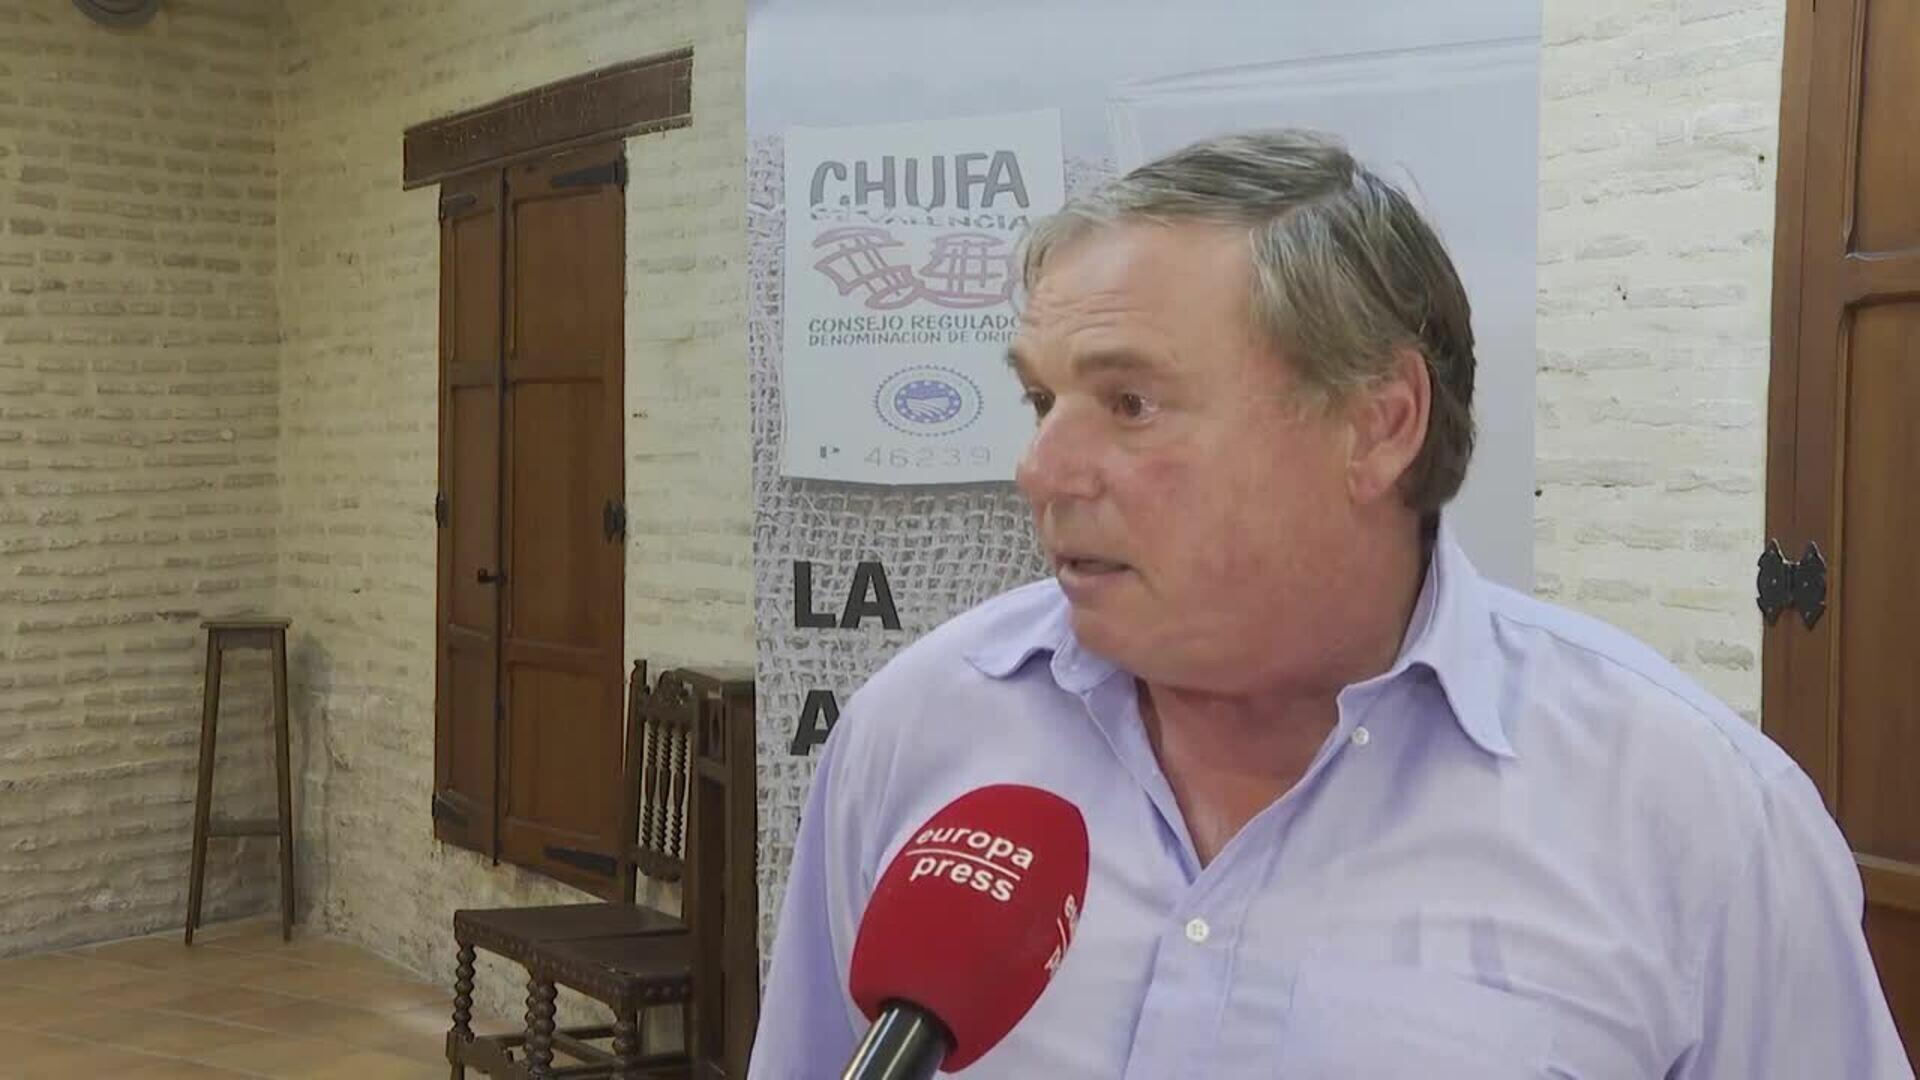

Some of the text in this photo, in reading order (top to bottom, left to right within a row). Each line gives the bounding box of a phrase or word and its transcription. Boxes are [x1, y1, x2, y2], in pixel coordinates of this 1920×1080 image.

[809, 150, 1031, 212] CHUFA
[808, 313, 1020, 334] CONSEJO REGULADO
[948, 331, 967, 344] DE
[792, 561, 902, 630] LA
[916, 825, 1035, 872] europa
[910, 856, 1015, 903] press
